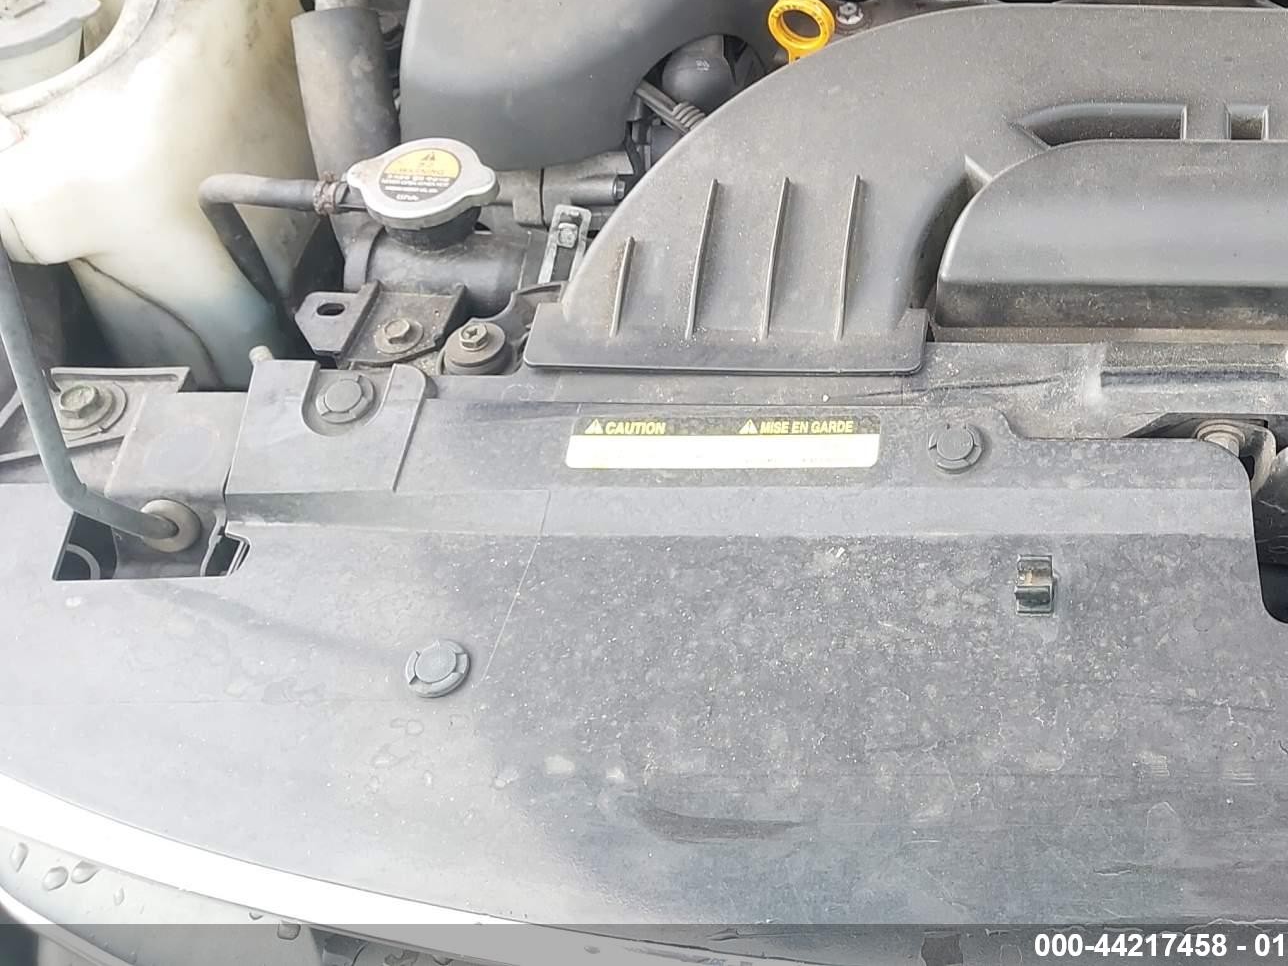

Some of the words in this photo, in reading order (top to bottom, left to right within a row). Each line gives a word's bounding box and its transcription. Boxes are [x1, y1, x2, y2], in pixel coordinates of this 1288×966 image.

[605, 421, 666, 435] CAUTION
[759, 421, 789, 434] MISE
[792, 421, 809, 434] EN
[811, 420, 854, 434] GARDE
